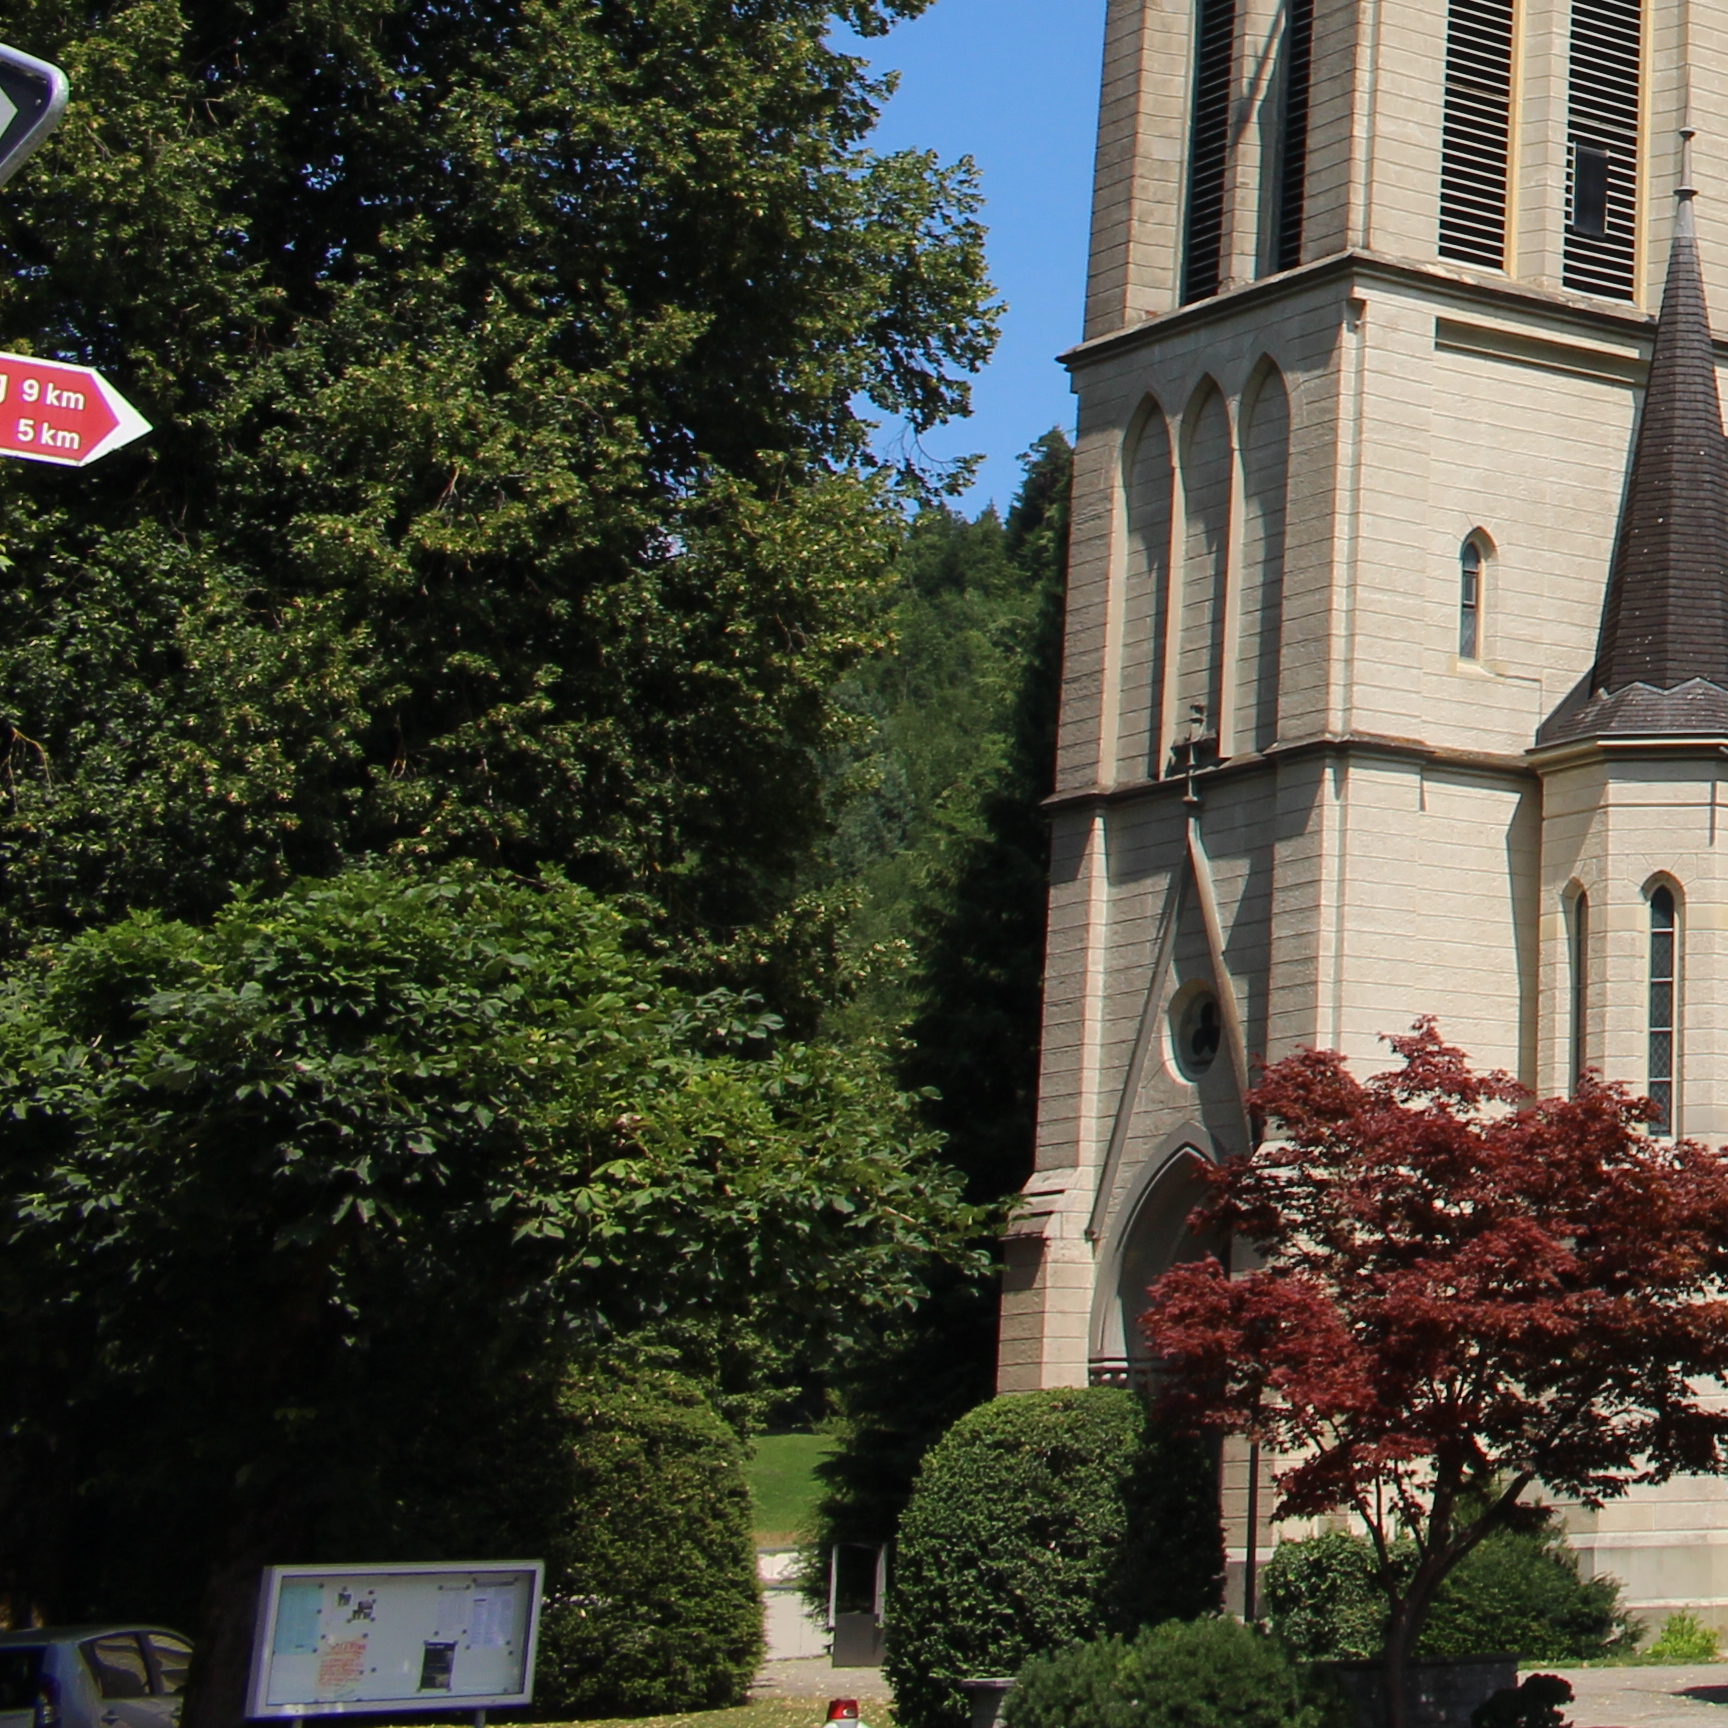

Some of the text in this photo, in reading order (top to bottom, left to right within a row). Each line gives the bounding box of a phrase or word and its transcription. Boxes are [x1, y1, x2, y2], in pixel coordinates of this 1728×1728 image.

[22, 378, 40, 402] 9
[46, 382, 85, 410] km
[18, 417, 80, 450] 5 km
